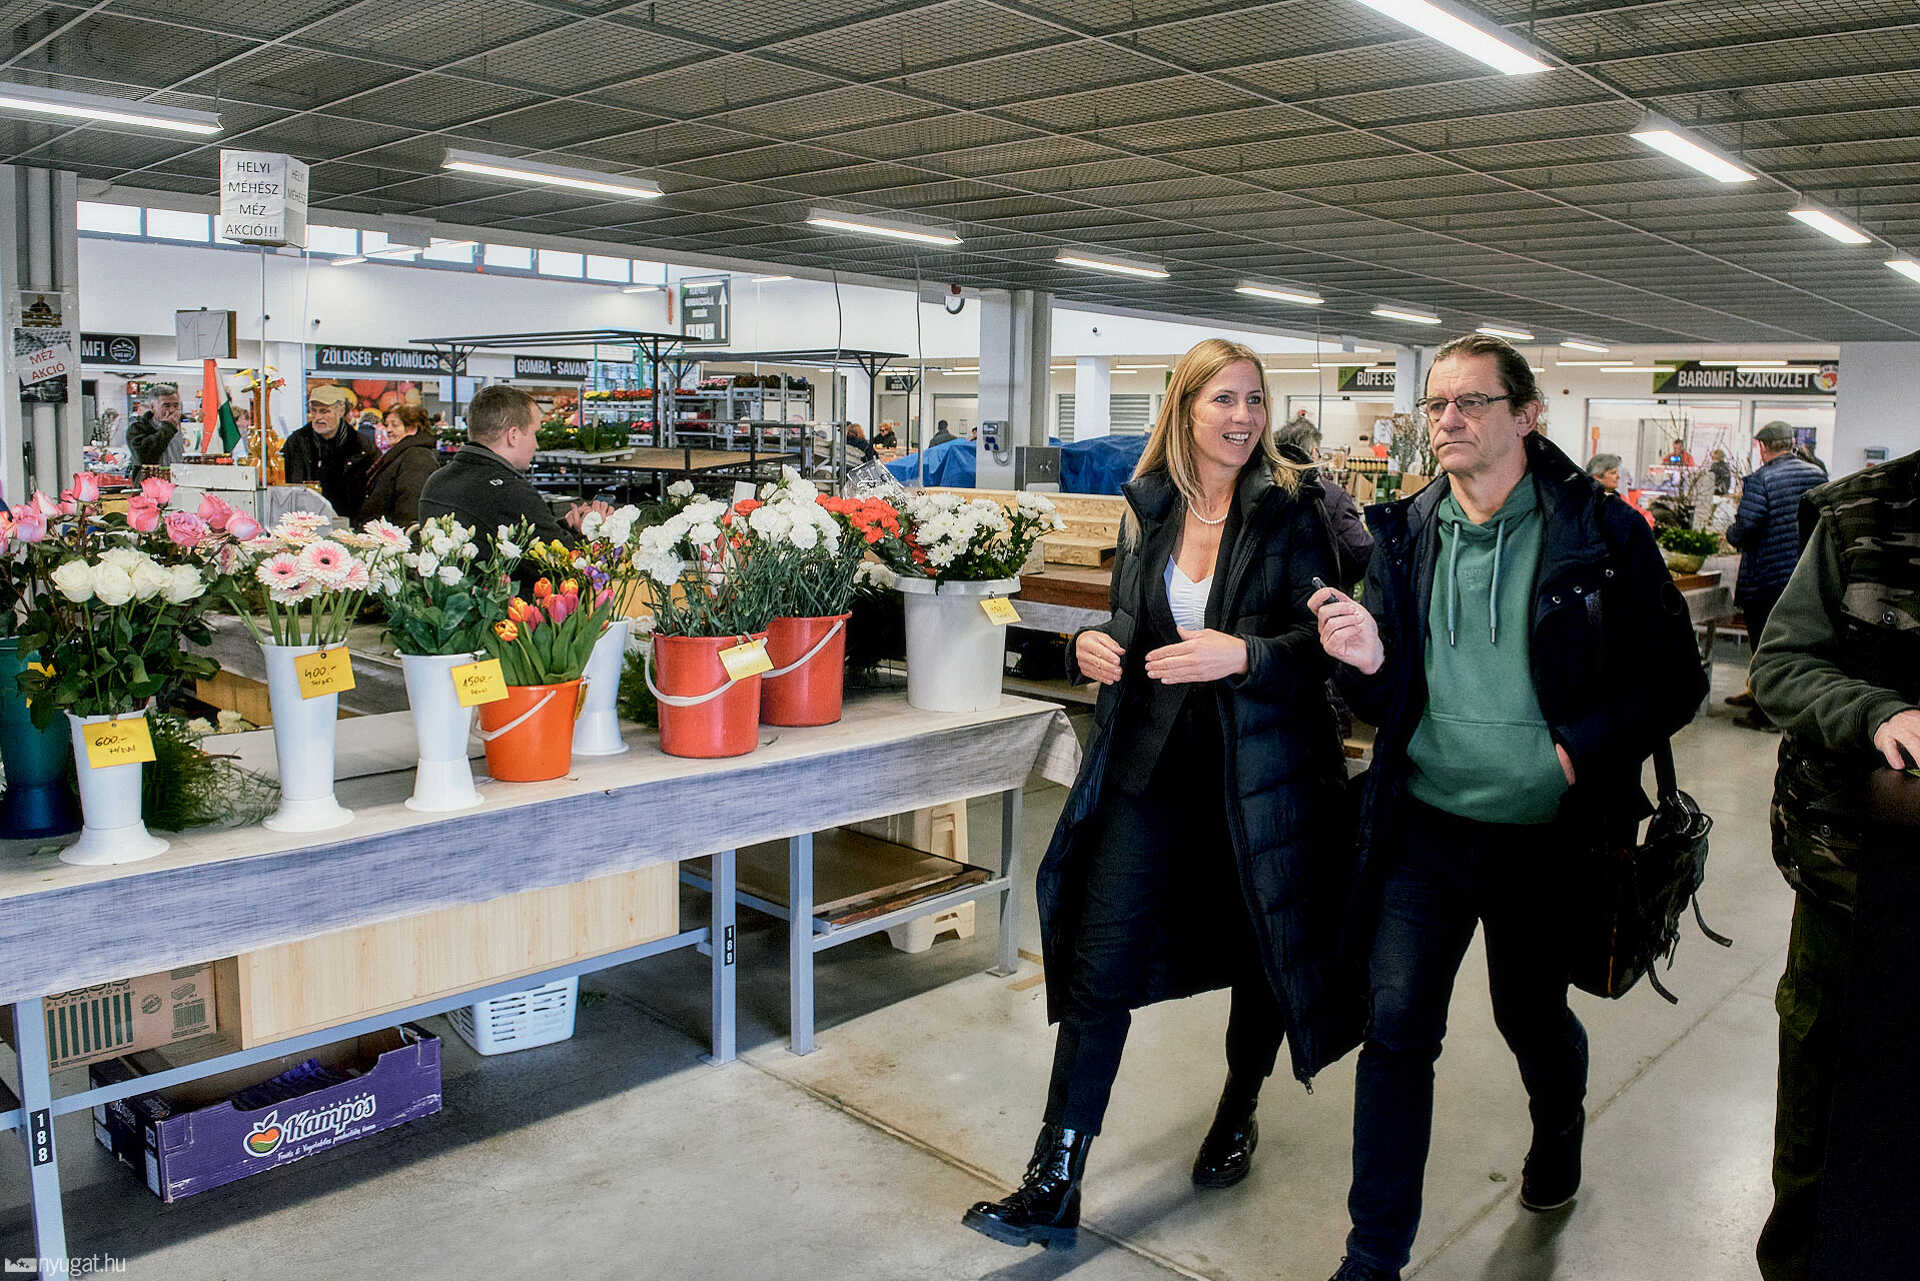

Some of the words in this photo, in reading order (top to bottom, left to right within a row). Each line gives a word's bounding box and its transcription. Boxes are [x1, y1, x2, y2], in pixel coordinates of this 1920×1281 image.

[237, 161, 271, 174] HELYI
[228, 180, 279, 195] MÉHÉSZ
[239, 203, 266, 216] MÉZ
[225, 223, 277, 238] AKCIÓ!!!
[29, 349, 55, 365] MÉZ
[81, 341, 106, 357] MFI
[322, 347, 371, 366] ZÖLDSÉG
[381, 350, 439, 369] GYÜMÖLCS
[31, 361, 66, 381] AKCIÓ
[517, 358, 552, 375] GOMBA
[1678, 370, 1734, 388] BAROMFI
[45, 993, 92, 1008] FLORAL
[98, 984, 132, 997] FOAM
[36, 1113, 48, 1162] 188
